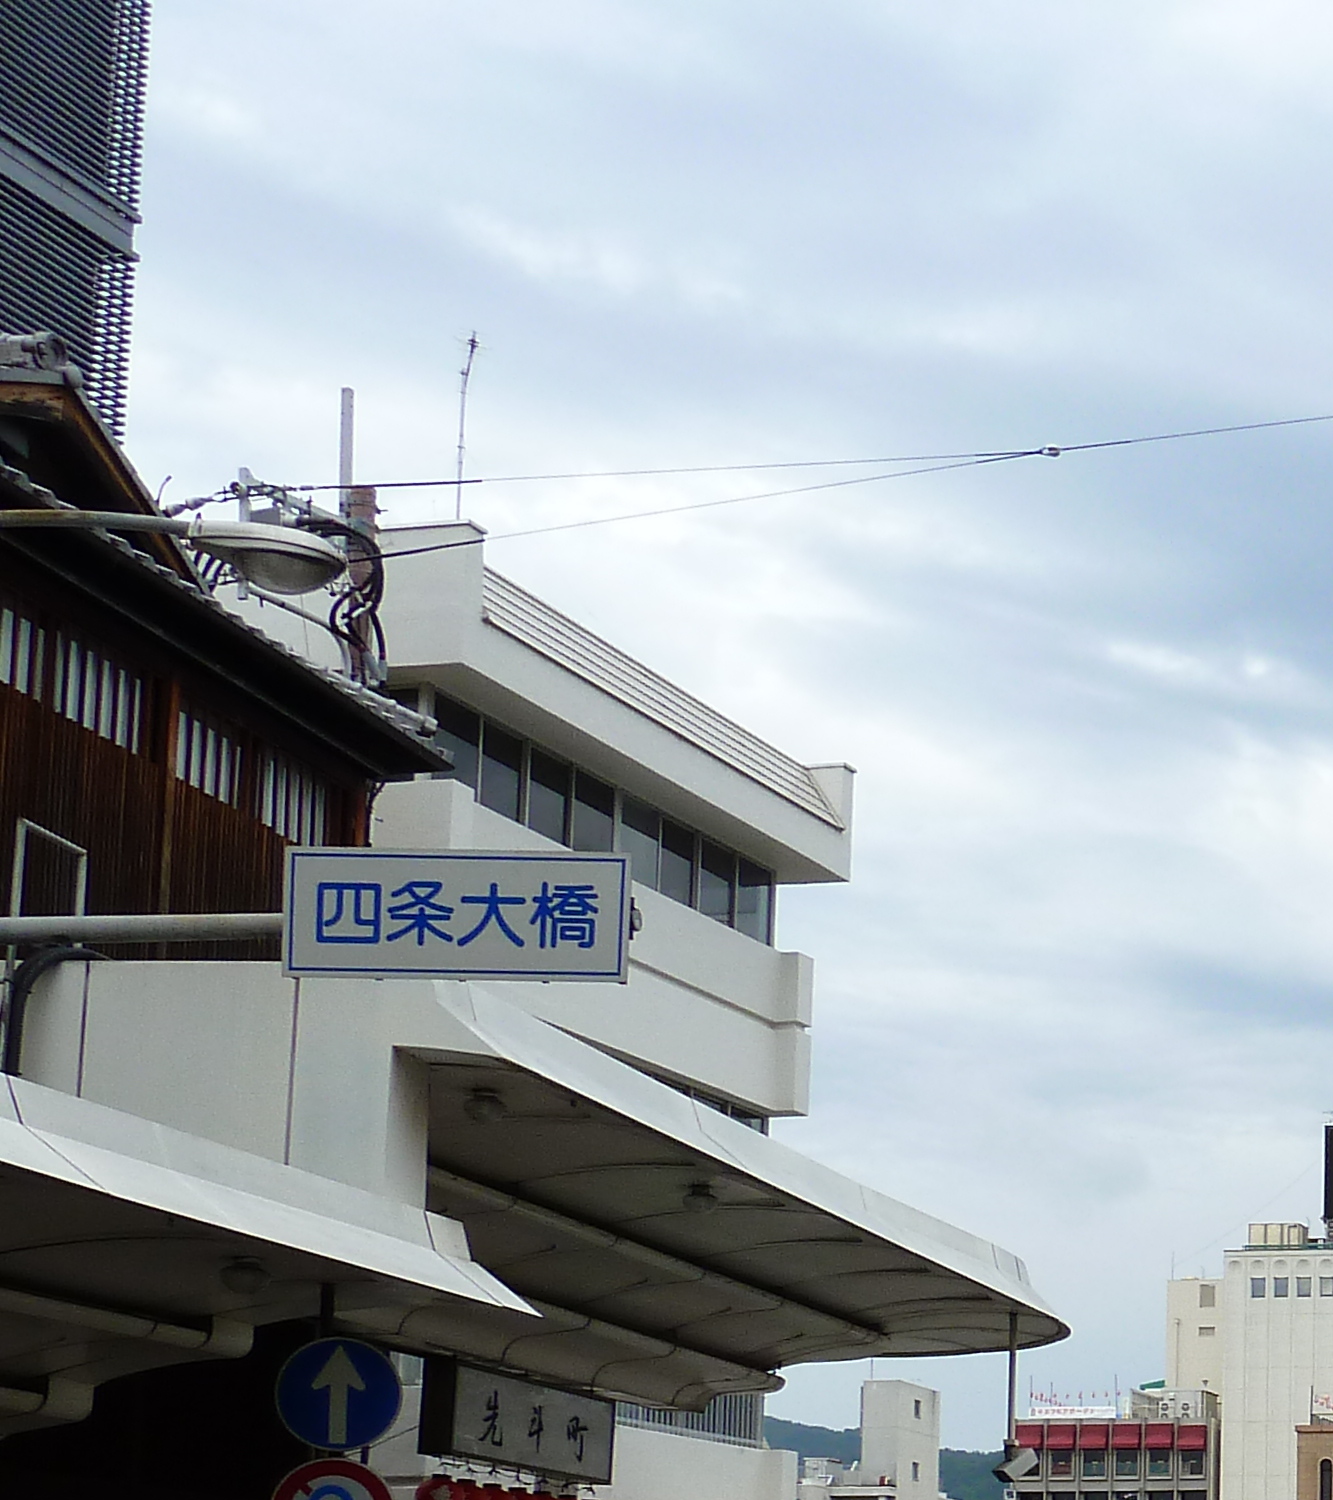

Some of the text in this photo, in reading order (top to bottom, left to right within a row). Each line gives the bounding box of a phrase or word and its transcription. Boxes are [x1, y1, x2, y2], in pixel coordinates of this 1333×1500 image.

[315, 881, 600, 949] 四条大橋
[477, 1389, 589, 1463] 先斗町
